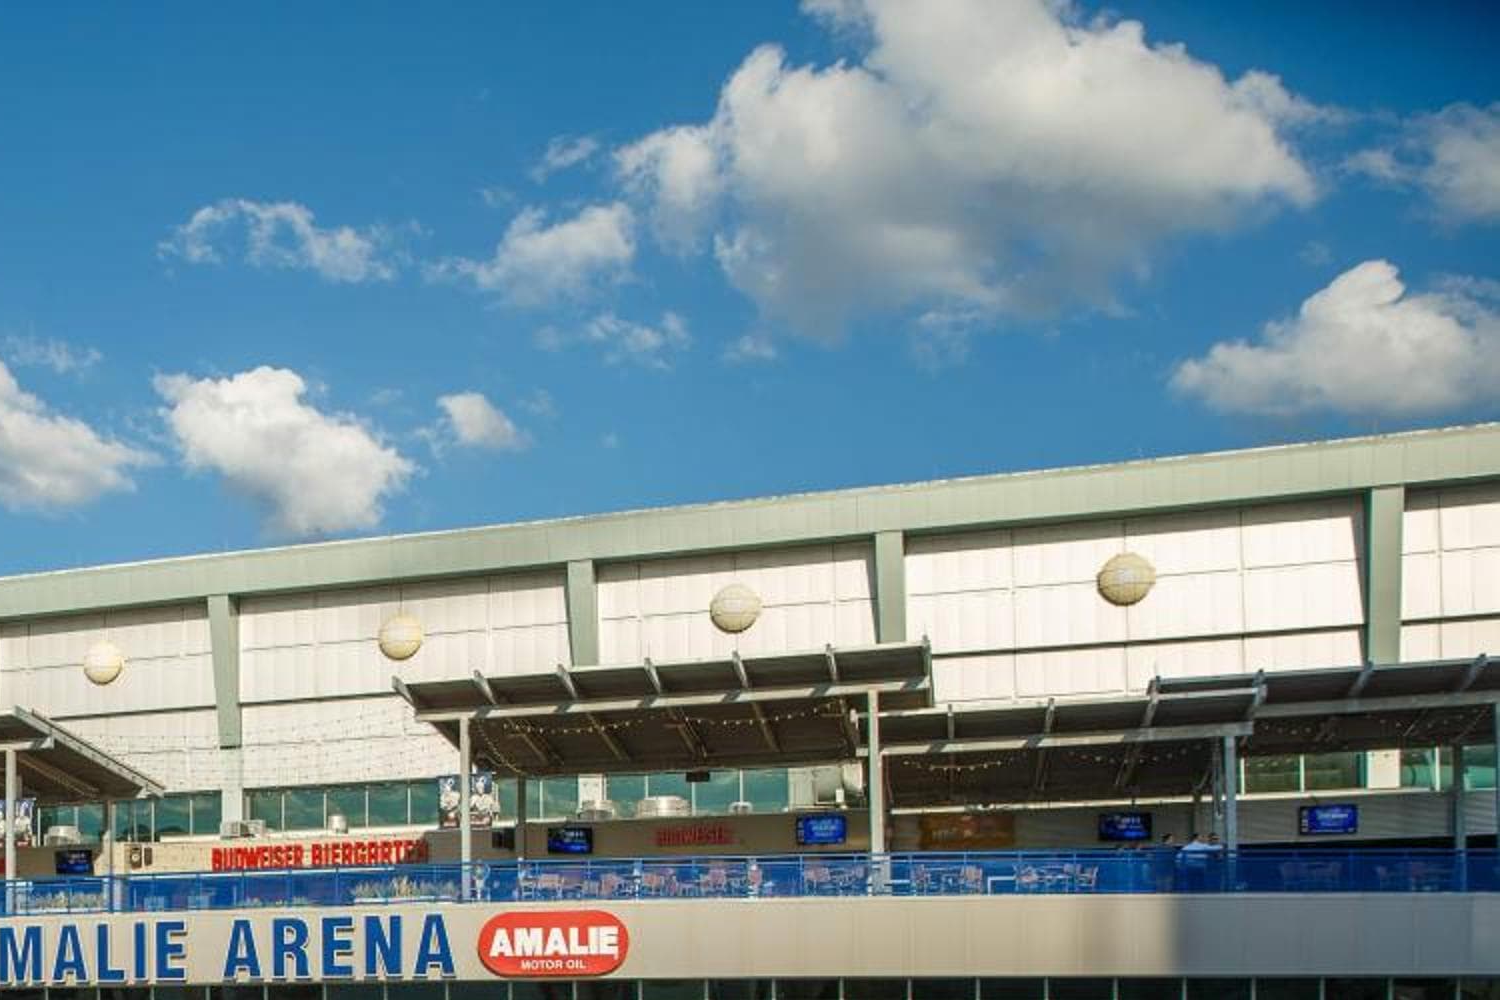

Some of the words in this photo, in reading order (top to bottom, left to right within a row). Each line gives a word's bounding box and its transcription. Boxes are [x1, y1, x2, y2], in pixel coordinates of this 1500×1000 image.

[211, 844, 304, 872] BUDWEISER
[222, 913, 457, 980] ARENA
[489, 925, 620, 960] AMALIE
[520, 959, 562, 971] MOTOR
[565, 960, 587, 971] OIL
